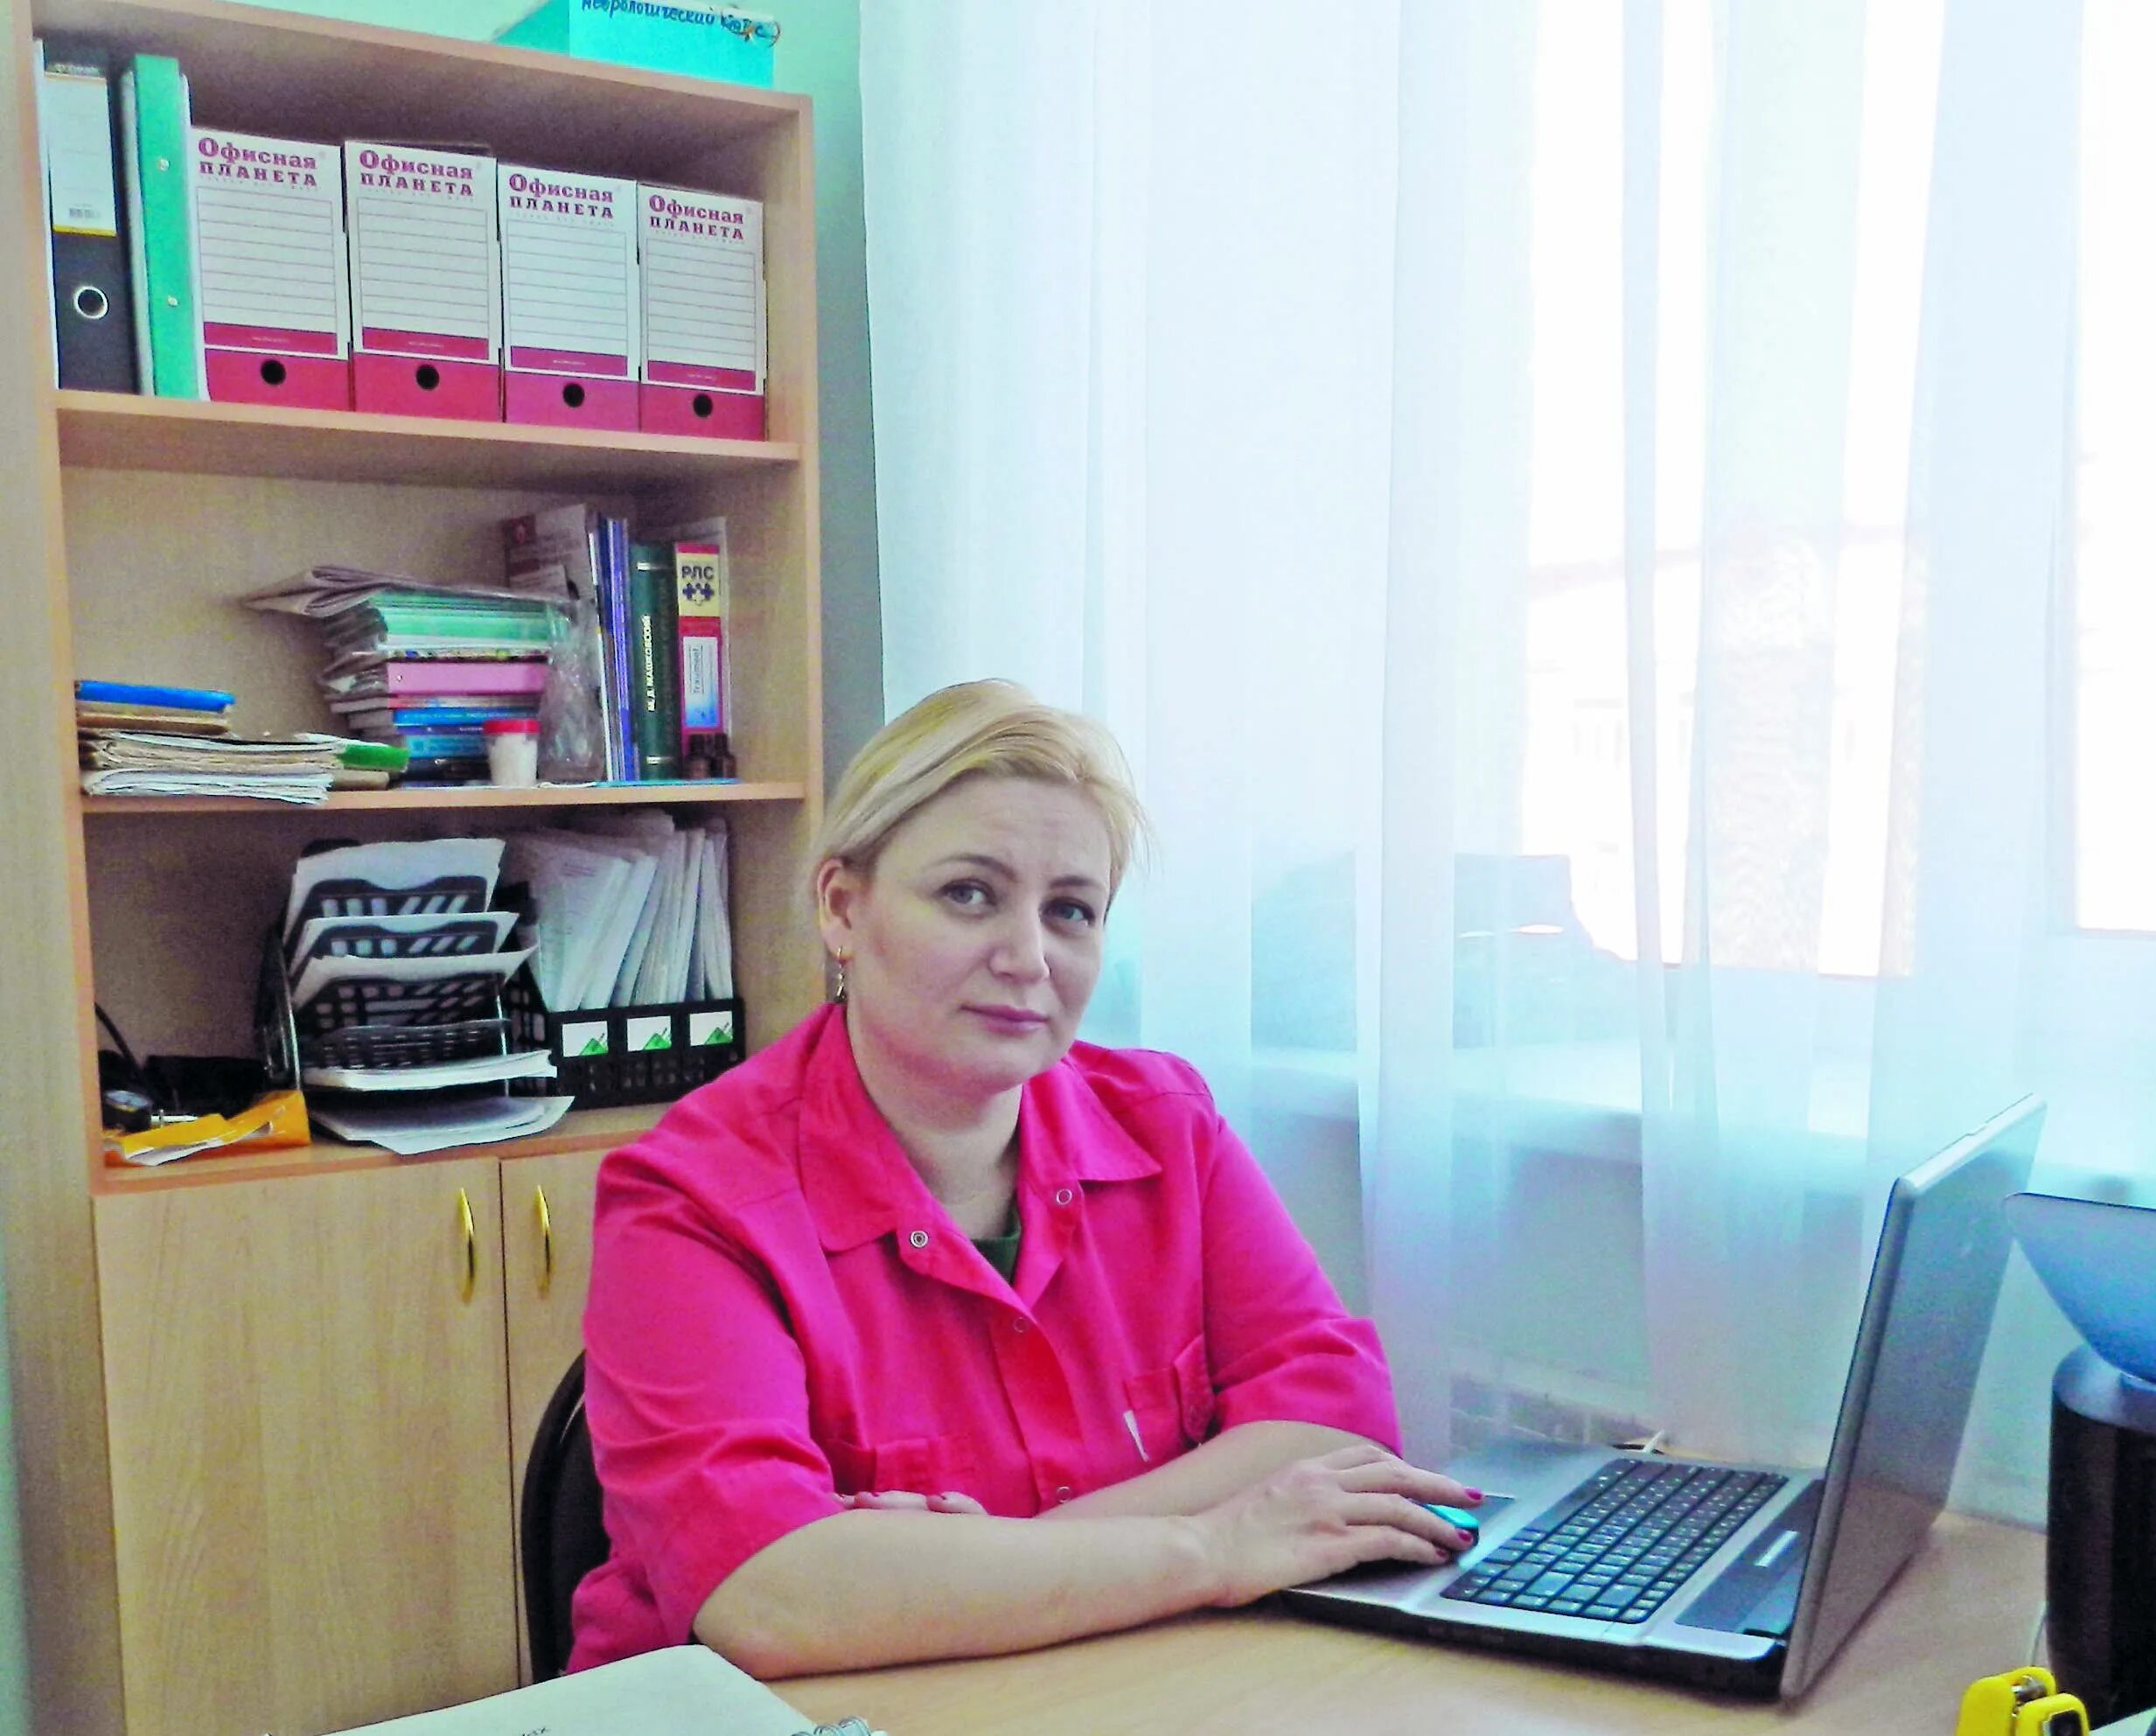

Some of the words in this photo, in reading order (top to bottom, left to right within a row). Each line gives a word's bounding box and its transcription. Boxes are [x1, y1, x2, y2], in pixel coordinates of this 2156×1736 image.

[199, 137, 317, 169] Офисная
[359, 150, 473, 179] Офисная
[199, 161, 317, 186] ПЛАНЕТА
[360, 172, 473, 197] ПЛАНЕТА
[509, 173, 613, 203] Офисная
[510, 196, 613, 219] ПЛАНЕТА
[649, 194, 743, 225] Офисная
[650, 216, 743, 240] ПЛАНЕТА
[681, 566, 714, 580] РЛС
